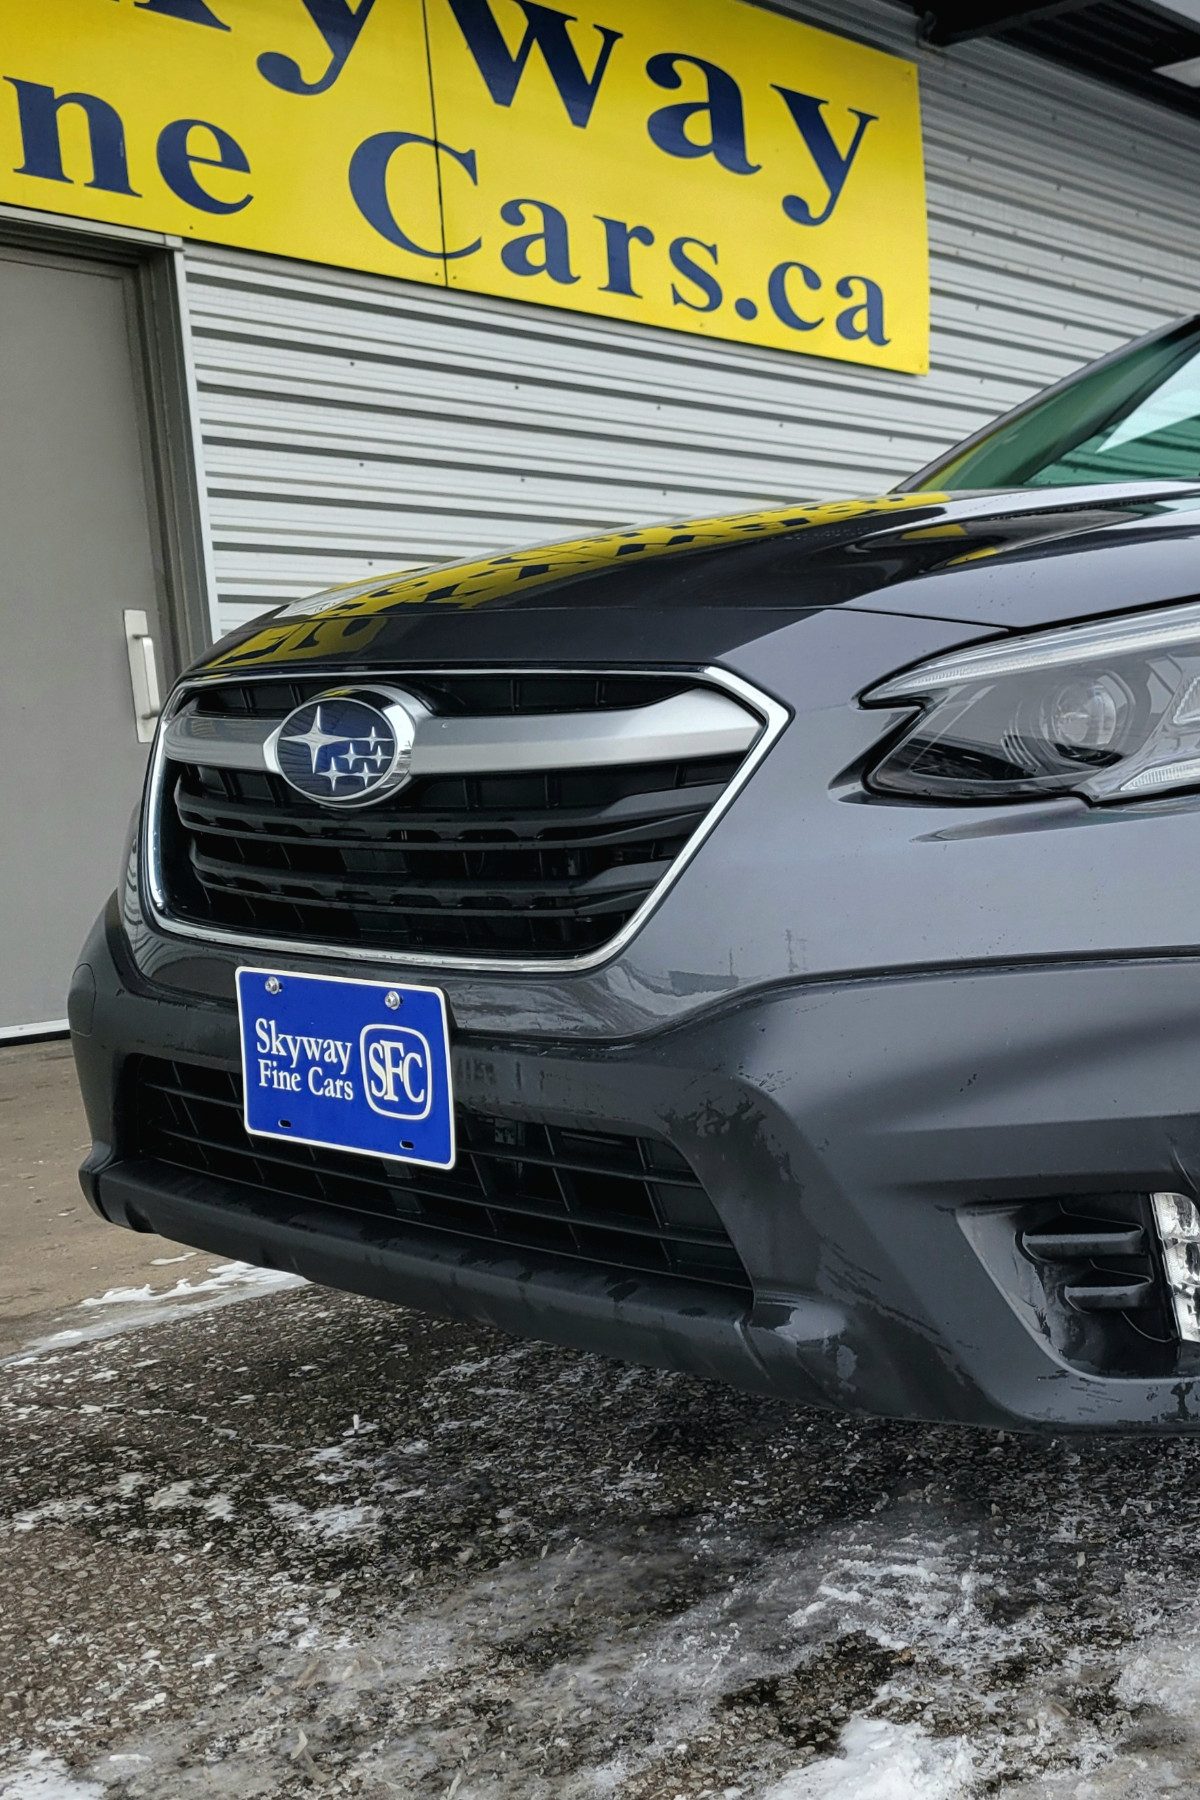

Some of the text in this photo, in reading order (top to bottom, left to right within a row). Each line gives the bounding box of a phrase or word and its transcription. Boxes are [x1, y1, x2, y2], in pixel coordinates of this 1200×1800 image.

[106, 0, 878, 226] yway
[348, 131, 891, 348] Cars.ca
[255, 1018, 352, 1075] Skyway
[368, 1040, 425, 1103] SFC
[258, 1058, 354, 1101] Fine Cars
